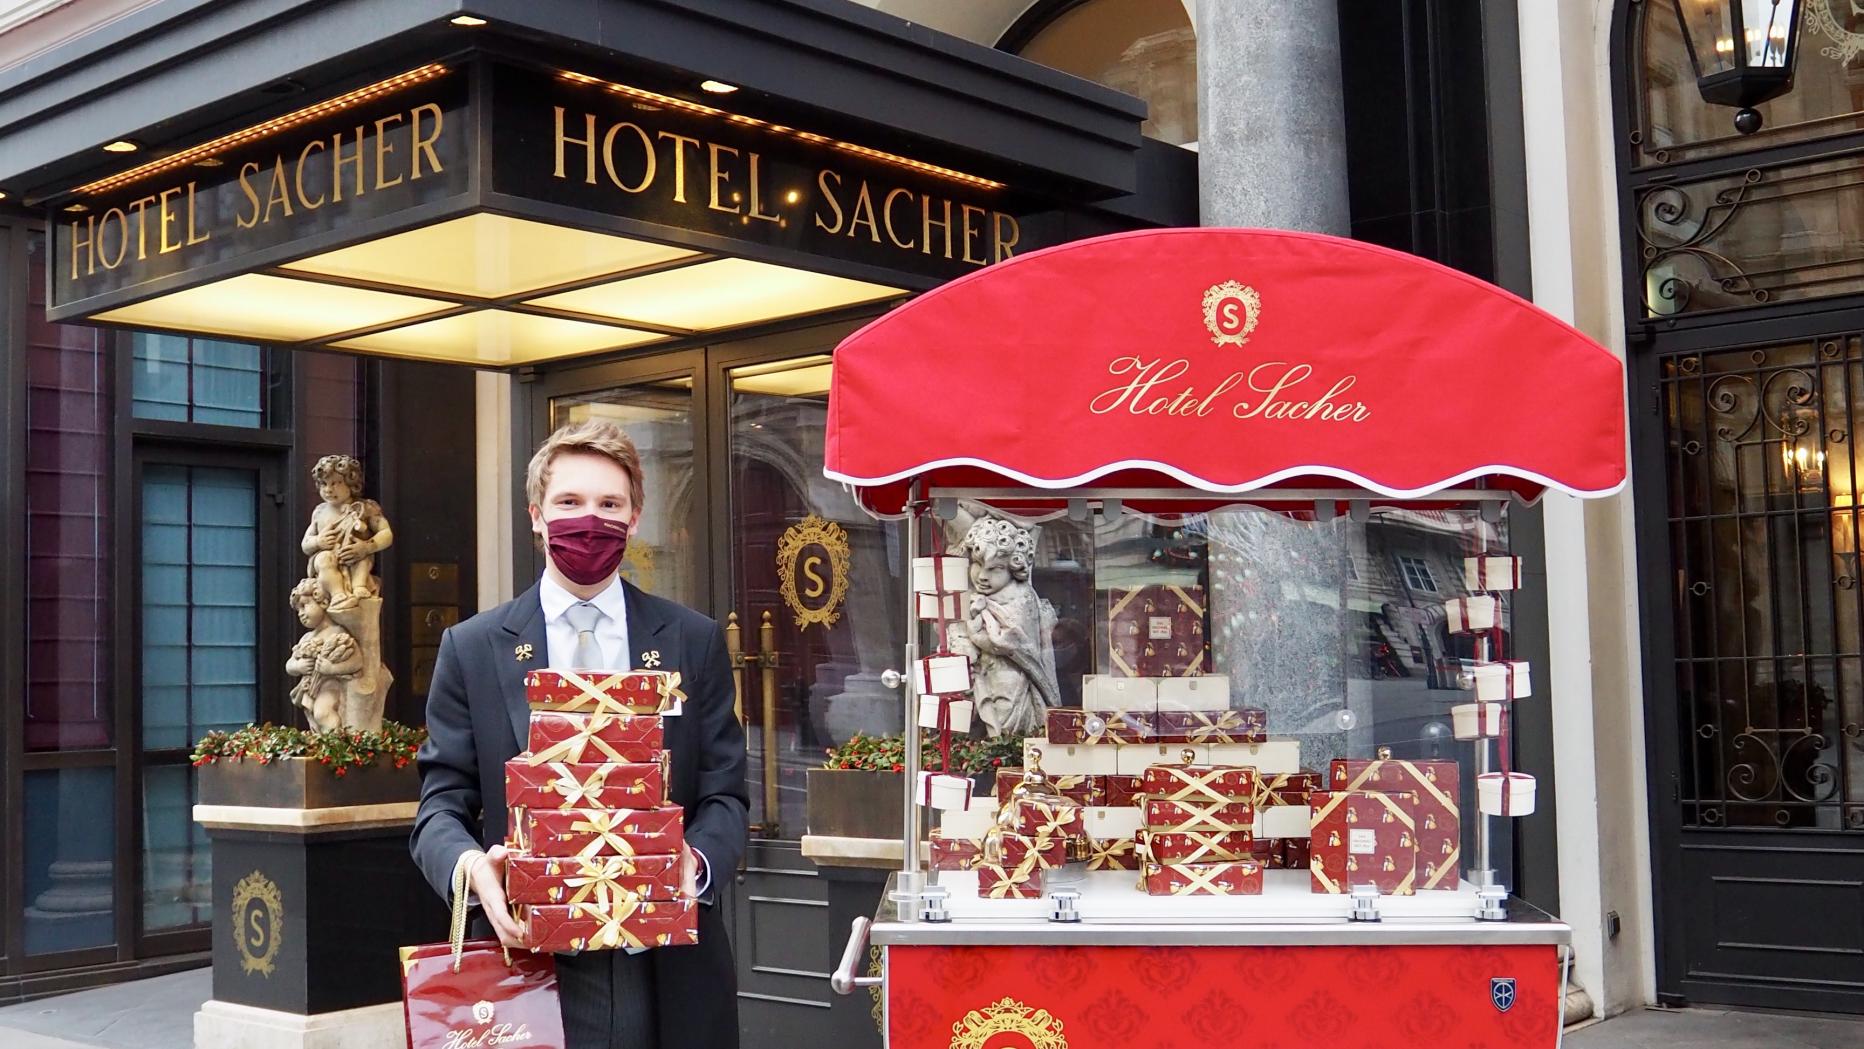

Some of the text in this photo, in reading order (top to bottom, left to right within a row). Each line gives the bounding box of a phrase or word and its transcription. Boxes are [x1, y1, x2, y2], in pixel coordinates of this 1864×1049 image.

[71, 102, 444, 280] HOTEL SACHER
[553, 106, 1020, 266] HOTEL SACHER
[1222, 303, 1240, 329] S
[1090, 354, 1371, 423] Hotel Sacher
[803, 556, 824, 598] S
[250, 909, 265, 947] S
[441, 1028, 491, 1049] Hotel
